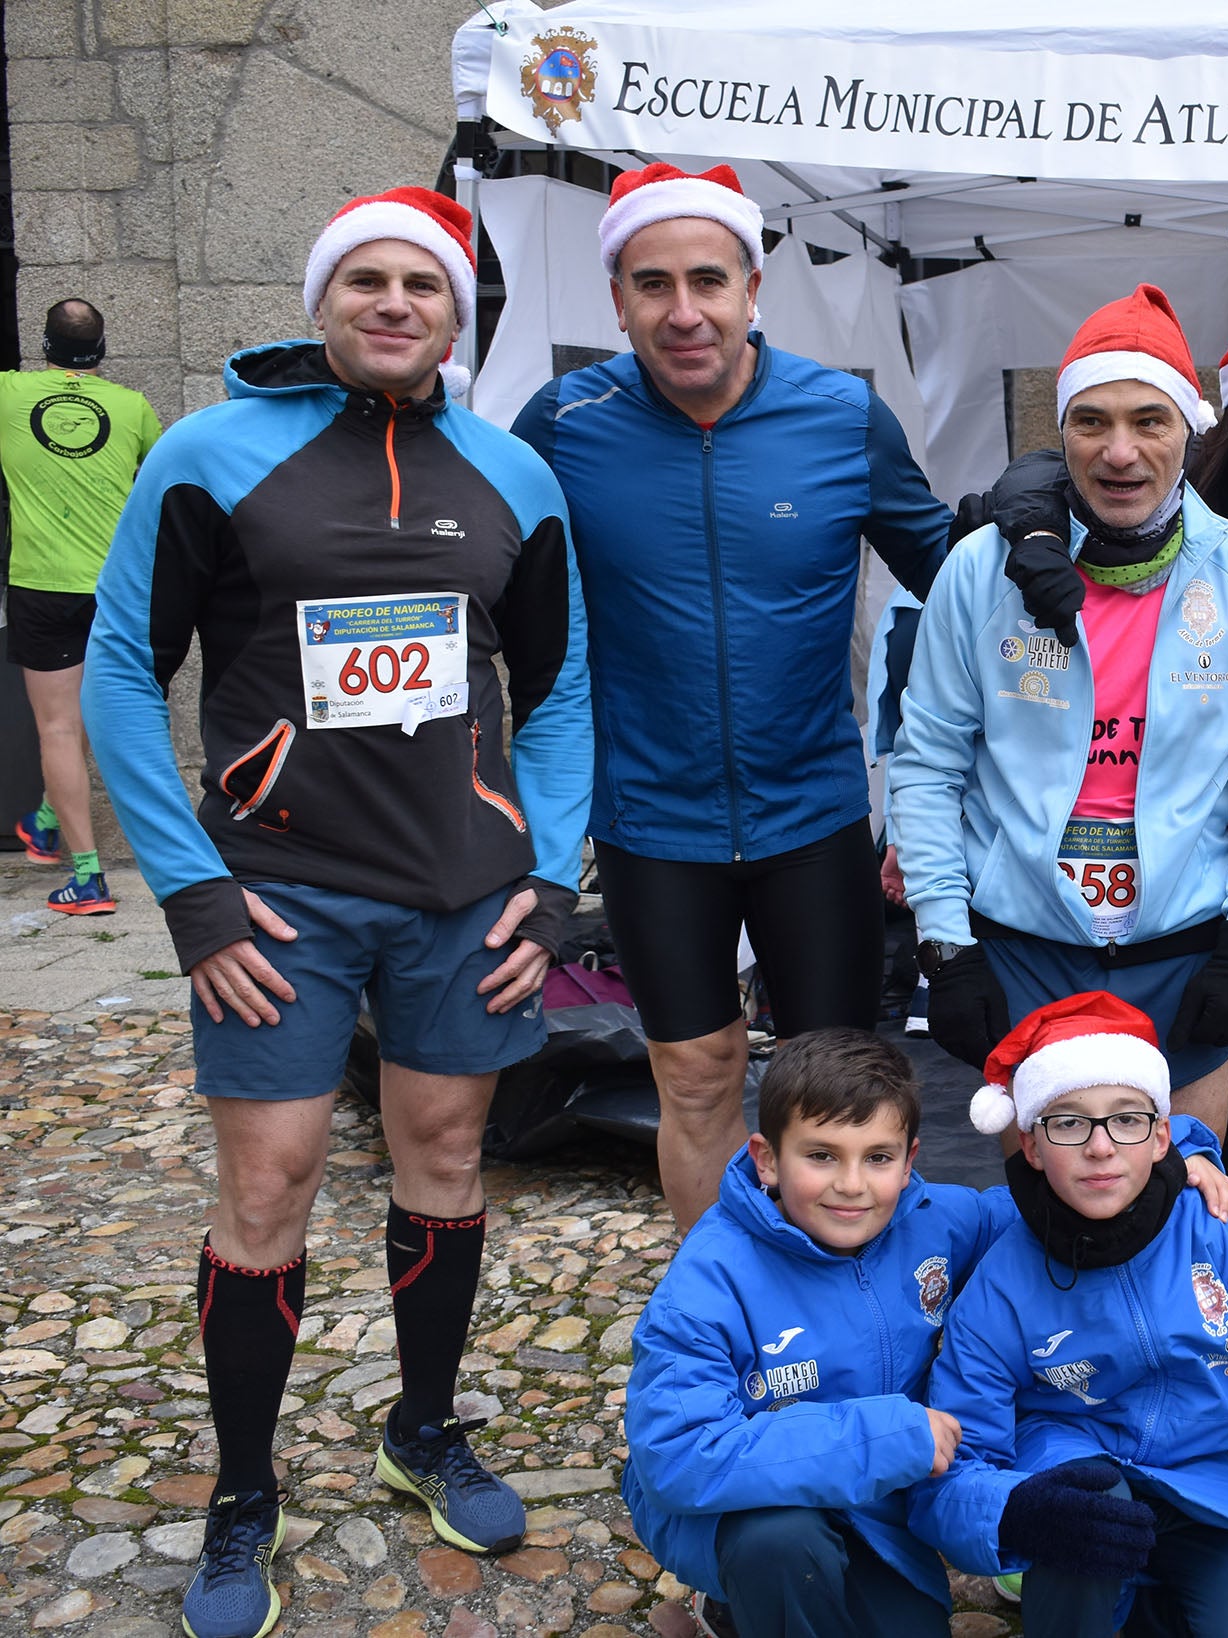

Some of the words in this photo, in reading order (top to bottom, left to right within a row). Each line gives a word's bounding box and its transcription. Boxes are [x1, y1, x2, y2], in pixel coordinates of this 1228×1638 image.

[612, 61, 805, 127] ESCUELA
[815, 75, 1053, 141] MUNICIPAL
[1064, 101, 1123, 143] DE
[430, 528, 466, 539] Kalenji
[327, 608, 374, 619] TROFEO
[376, 606, 391, 616] DE
[393, 603, 440, 615] NAVIDAD
[391, 622, 435, 632] SALAMANCA
[338, 642, 433, 696] 602
[1030, 652, 1069, 670] PRIETO
[338, 710, 372, 718] Salamanca
[1089, 827, 1104, 836] DE
[767, 1360, 817, 1387] LUENGO
[774, 1376, 819, 1398] PRIETO
